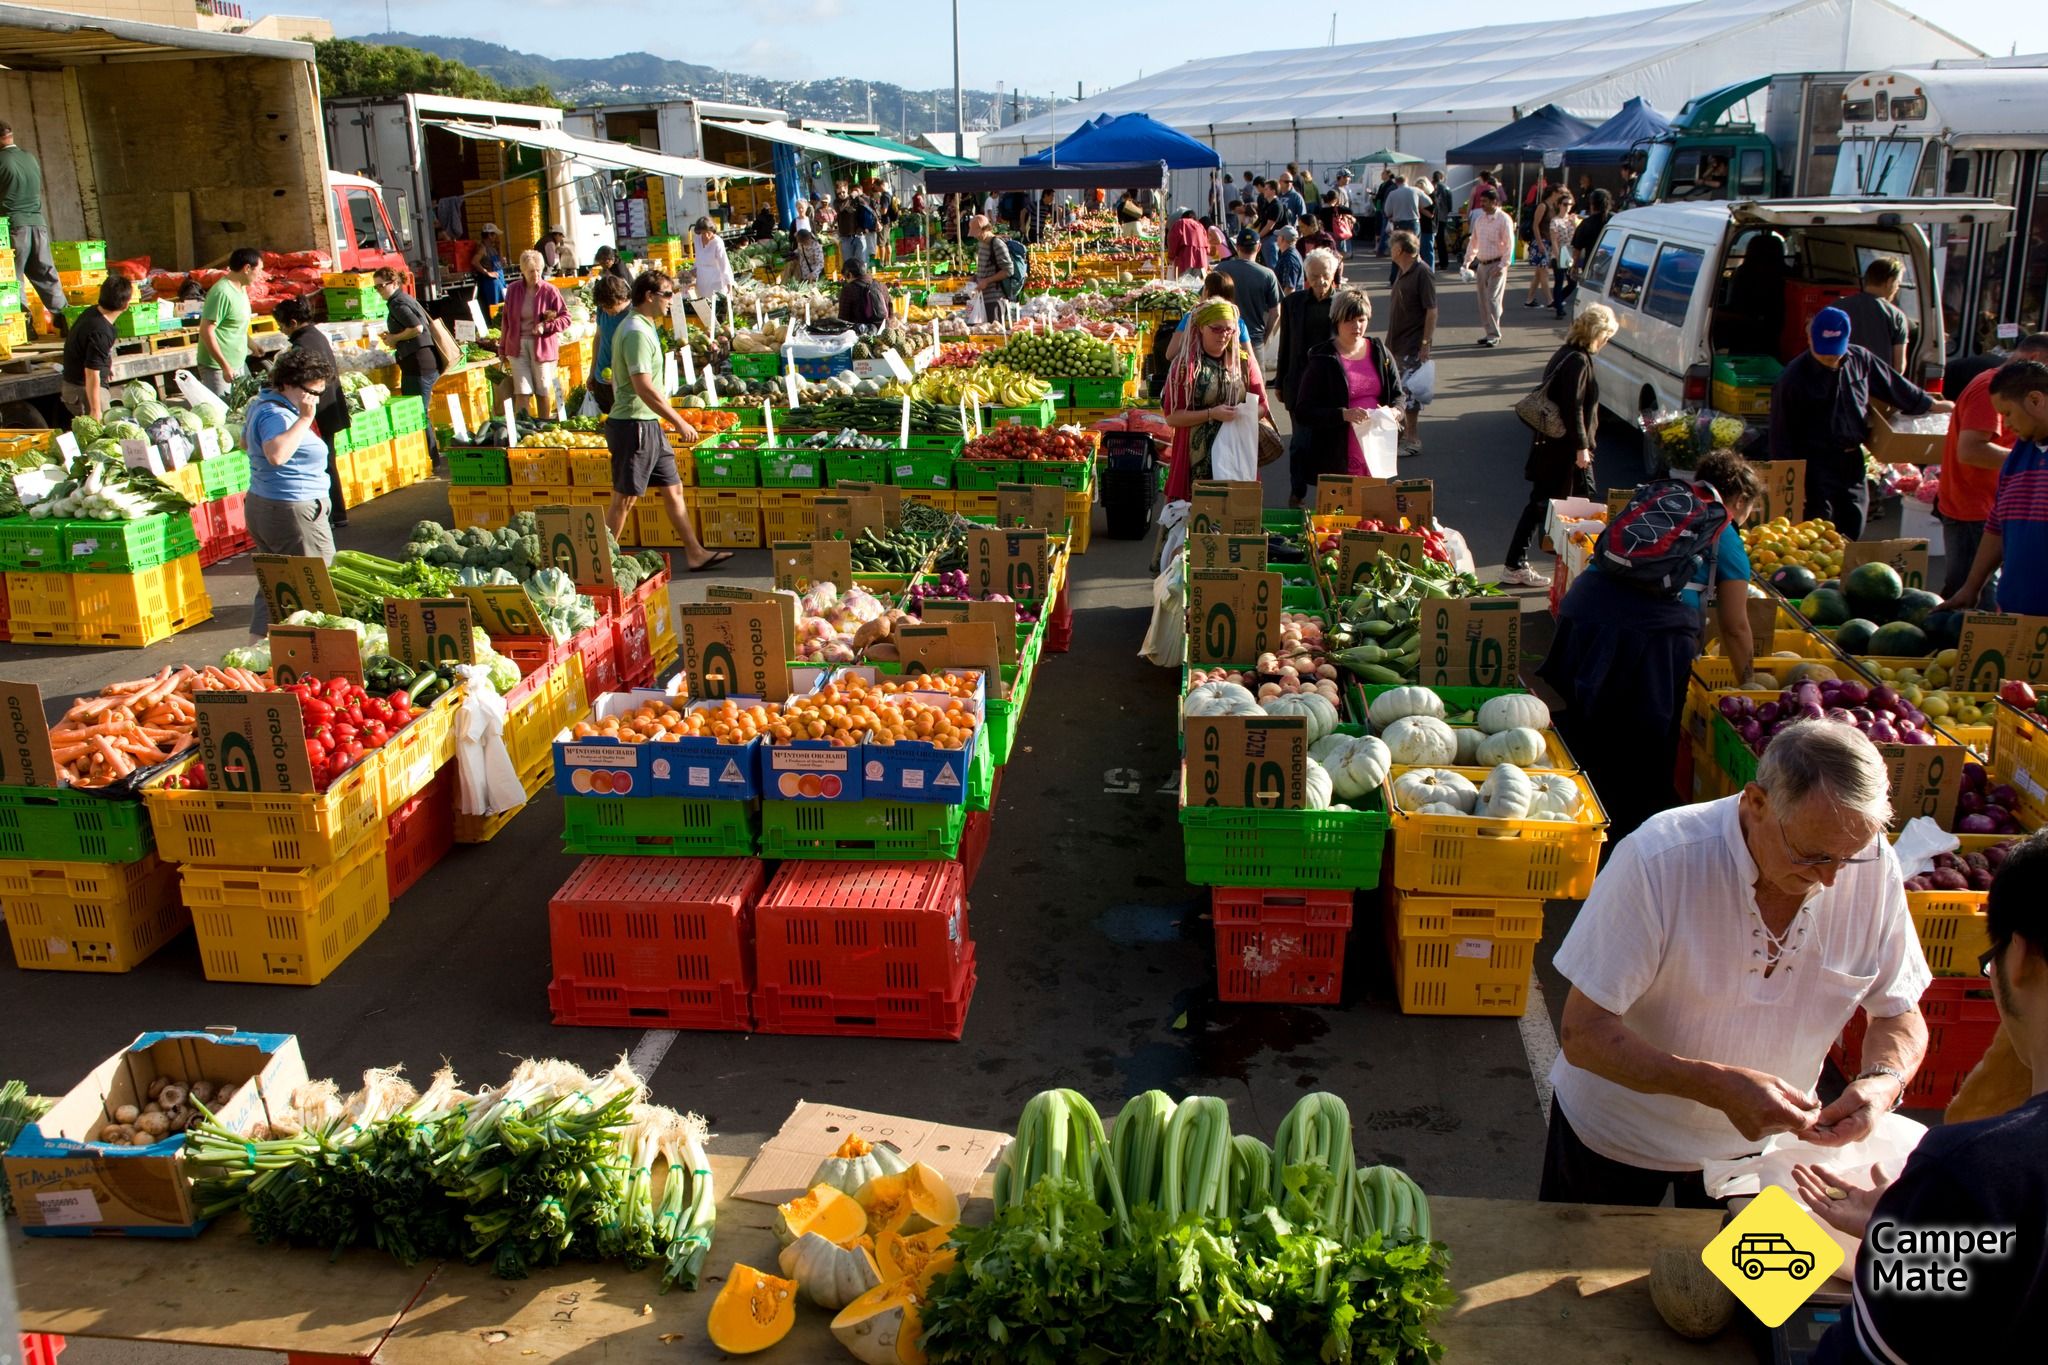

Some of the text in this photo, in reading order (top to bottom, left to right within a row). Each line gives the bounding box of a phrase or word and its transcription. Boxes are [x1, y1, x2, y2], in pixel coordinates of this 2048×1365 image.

[685, 623, 699, 670] Gracio
[749, 618, 767, 667] Gracio
[8, 695, 29, 745] Gracio
[199, 711, 217, 760] Gracio
[267, 708, 289, 760] Gracio
[602, 748, 635, 756] ORCHARD
[1291, 736, 1303, 801] Bananas
